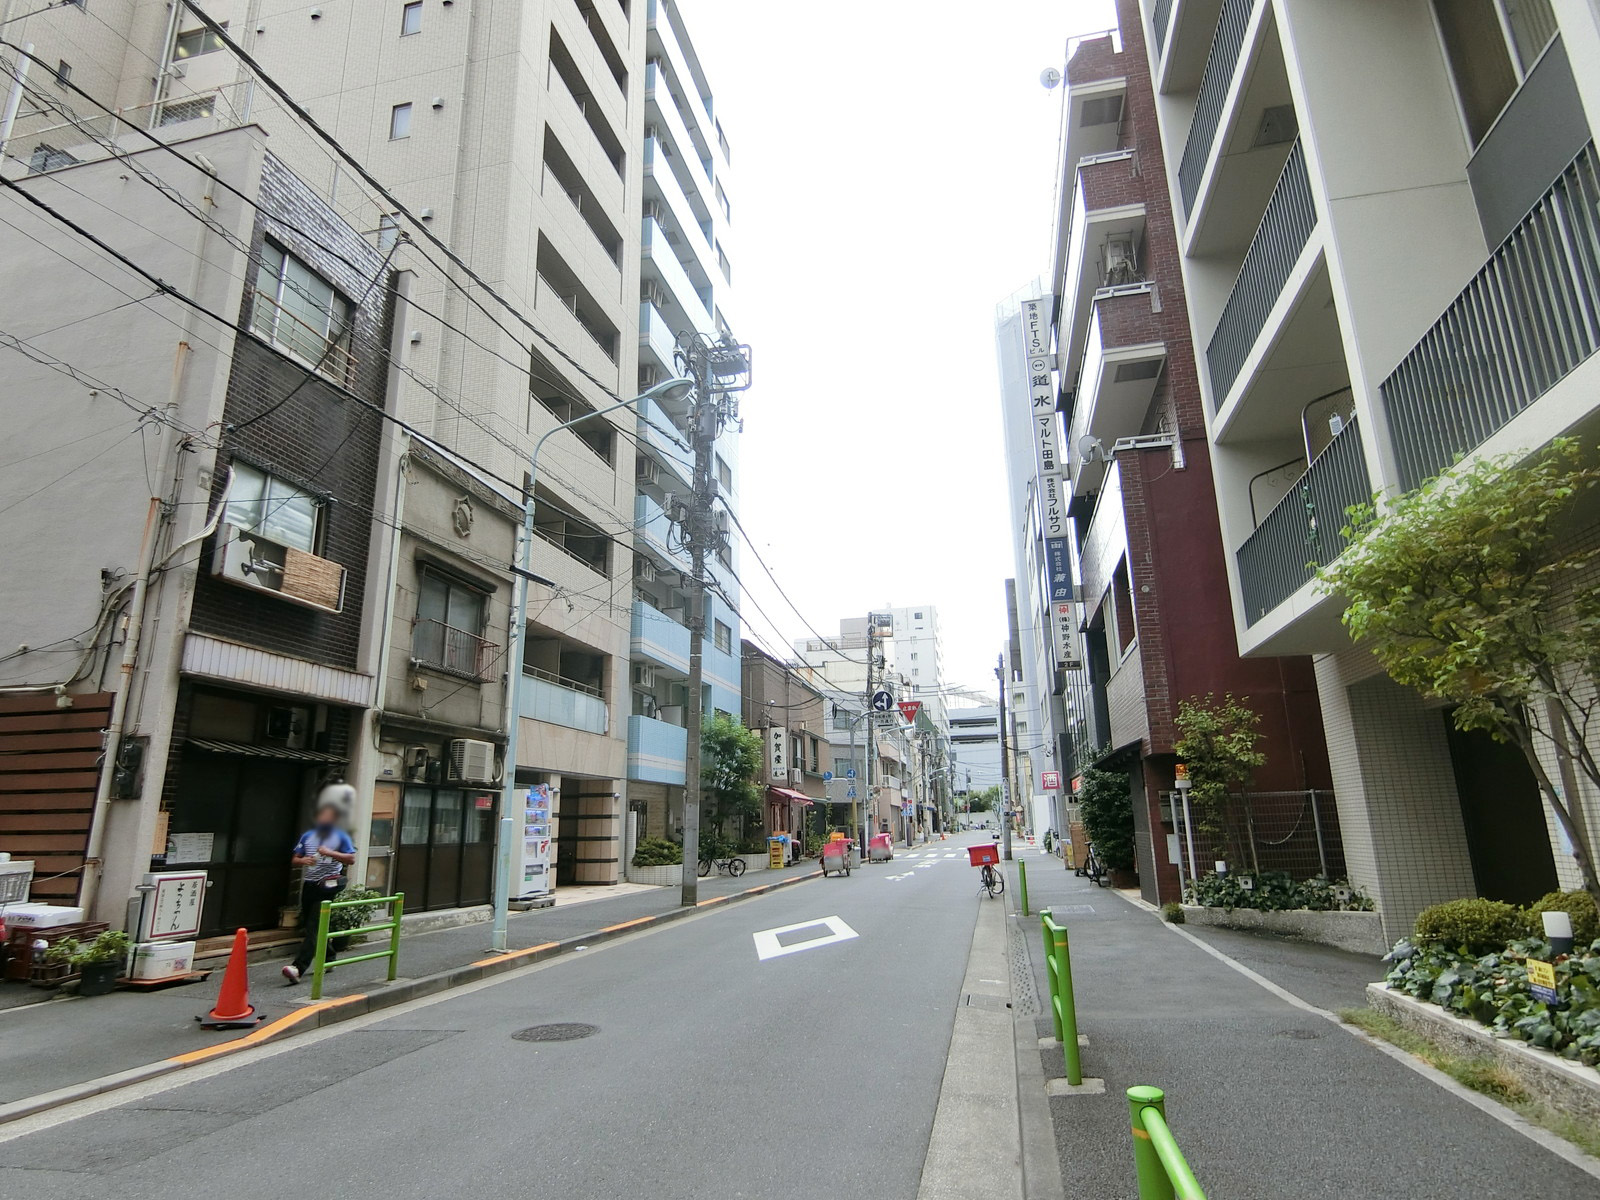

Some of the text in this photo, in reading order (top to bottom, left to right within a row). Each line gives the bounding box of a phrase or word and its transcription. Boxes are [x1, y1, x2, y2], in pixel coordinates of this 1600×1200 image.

[1038, 417, 1055, 471] マルト田島
[1043, 773, 1058, 788] 酒
